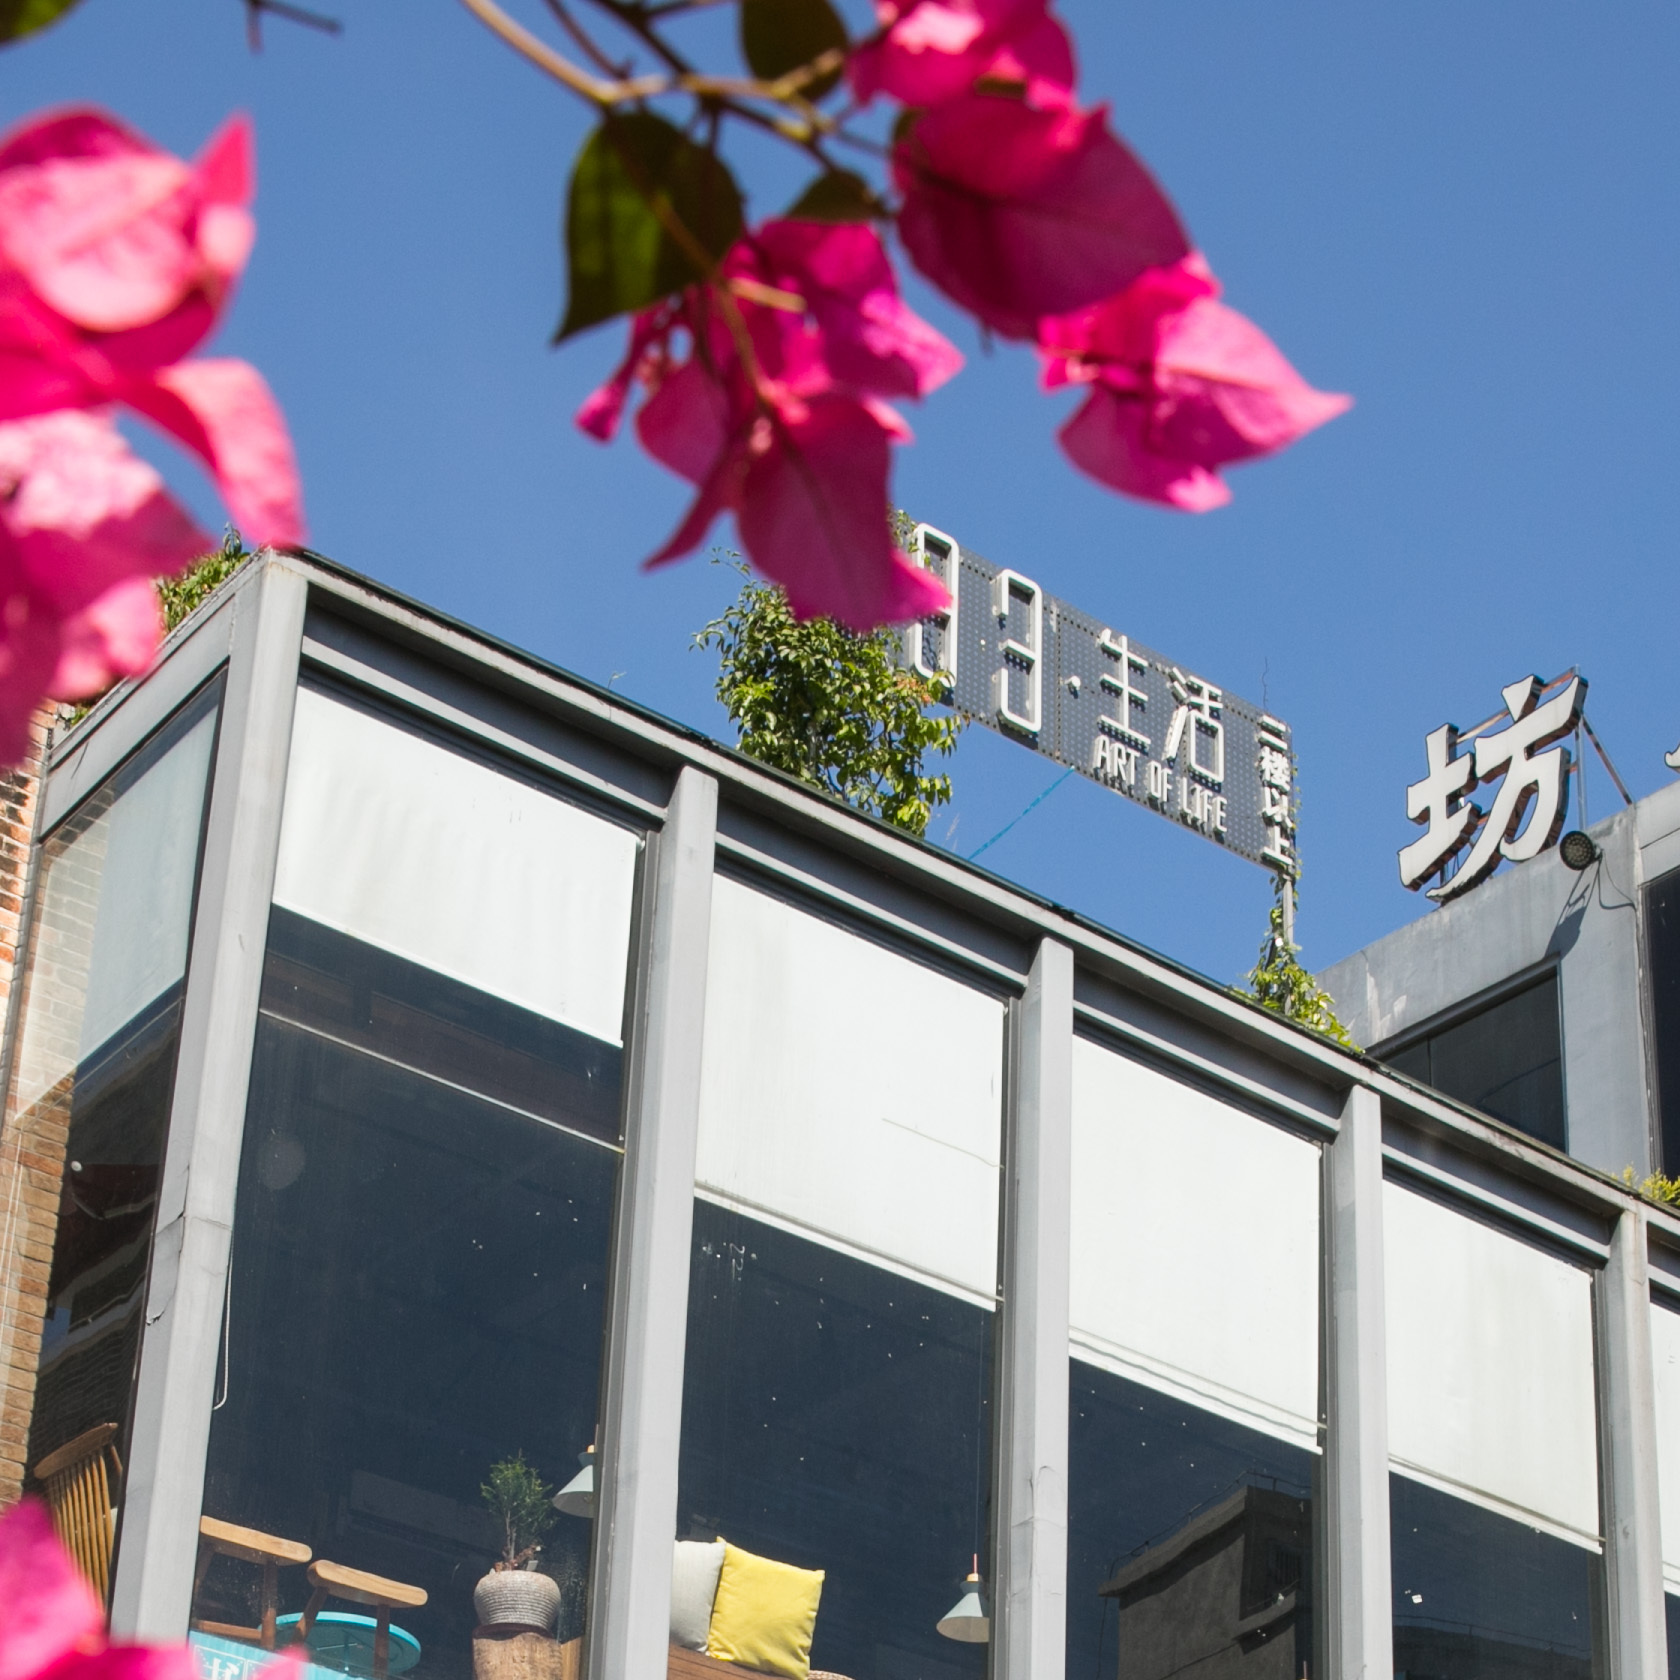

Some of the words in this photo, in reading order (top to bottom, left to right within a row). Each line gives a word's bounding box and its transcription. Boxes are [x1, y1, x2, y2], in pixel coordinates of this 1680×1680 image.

[1093, 735, 1141, 785] ART
[1149, 760, 1173, 801] OF
[1182, 777, 1227, 832] LIFE
[1259, 714, 1294, 866] 二楼以上
